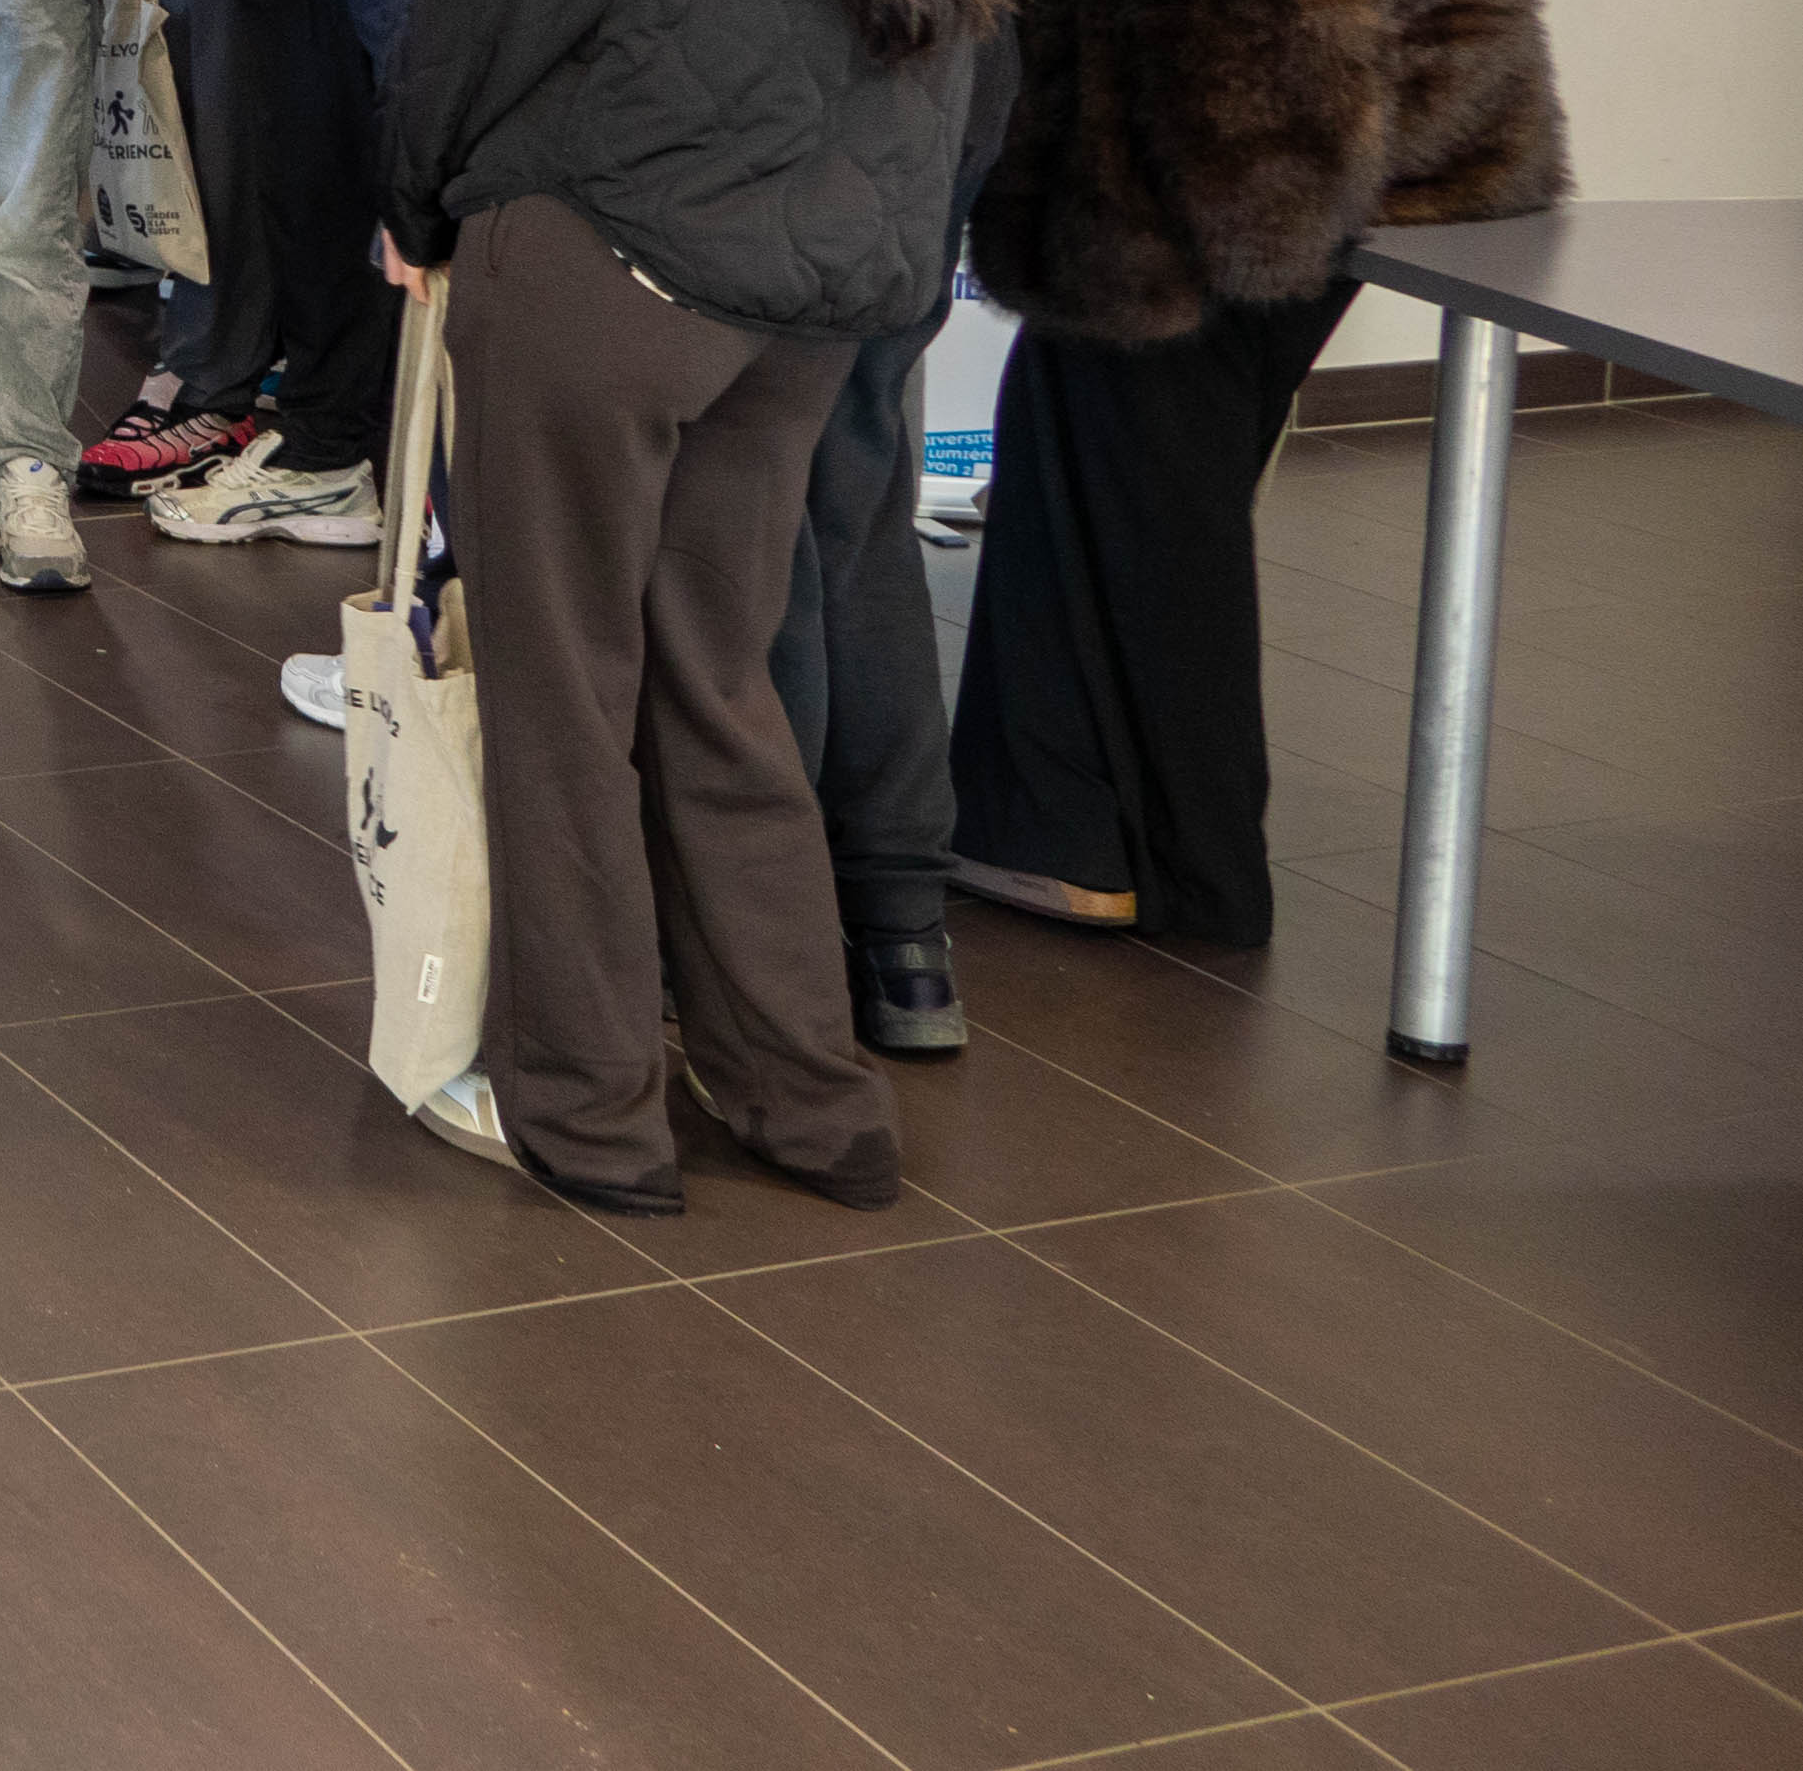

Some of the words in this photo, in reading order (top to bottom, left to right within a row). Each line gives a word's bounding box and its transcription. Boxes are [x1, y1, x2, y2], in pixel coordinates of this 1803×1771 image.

[111, 43, 139, 57] LYO
[928, 448, 992, 460] Lumièr
[925, 461, 957, 473] yon
